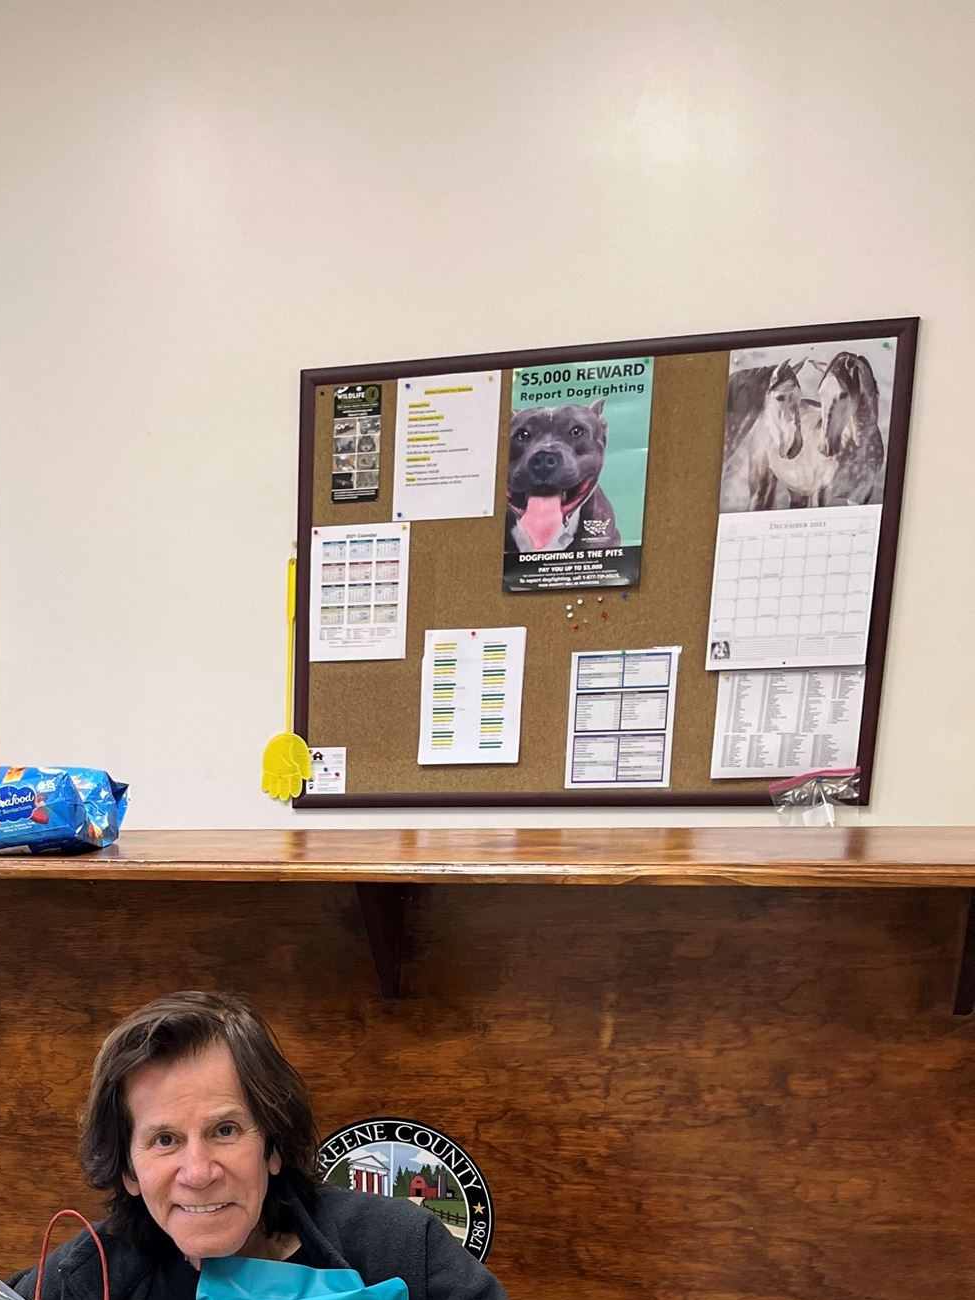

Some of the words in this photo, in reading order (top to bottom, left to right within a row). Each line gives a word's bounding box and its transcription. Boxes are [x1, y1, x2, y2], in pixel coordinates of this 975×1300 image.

[521, 369, 571, 386] $5,000
[576, 363, 645, 381] REWARD
[337, 390, 365, 400] WILDLIFE
[520, 389, 561, 403] Report
[567, 383, 644, 399] Dogfighting
[519, 551, 574, 562] DOGFIGHTING
[587, 550, 603, 558] THE
[319, 1124, 388, 1173] REENE
[395, 1124, 482, 1191] COUNTY
[468, 1221, 487, 1251] 1786
